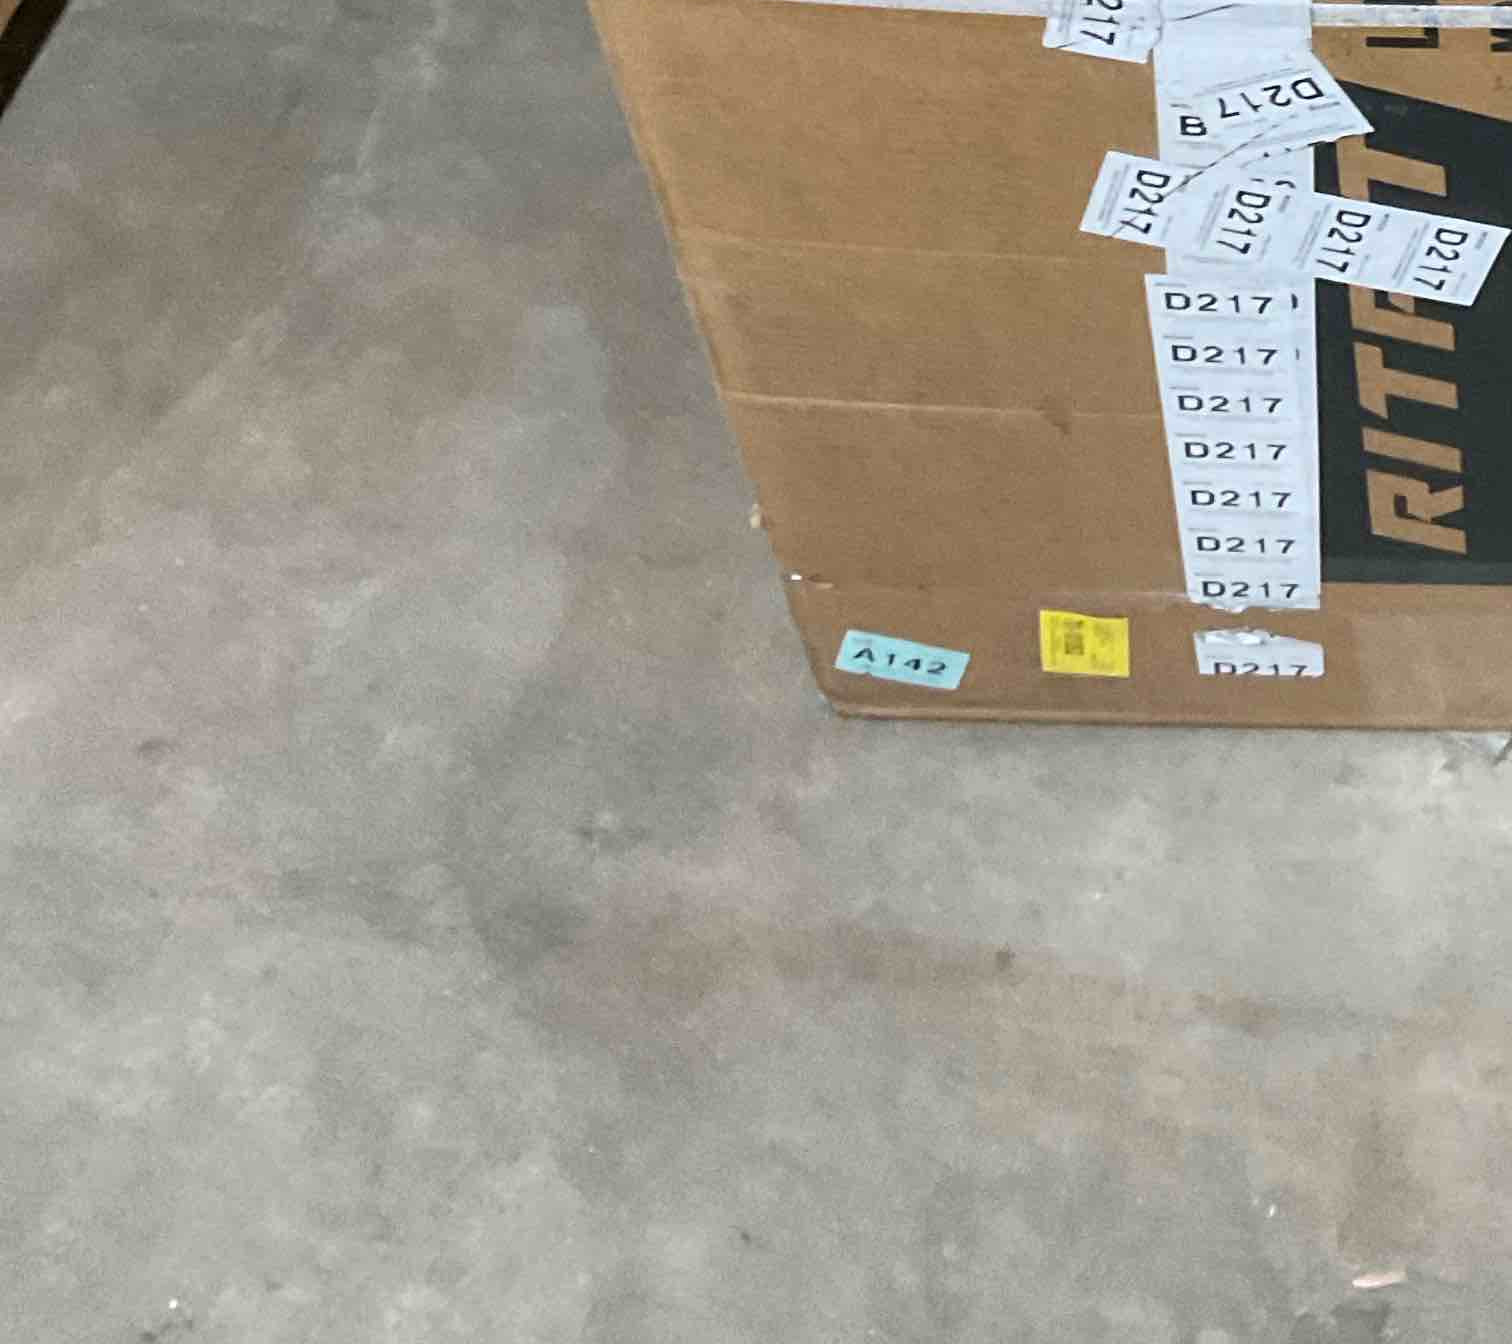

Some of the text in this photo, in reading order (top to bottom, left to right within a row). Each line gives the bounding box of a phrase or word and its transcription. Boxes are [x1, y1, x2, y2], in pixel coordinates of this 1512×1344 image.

[1217, 76, 1325, 119] D217
[1119, 169, 1172, 235] D217
[1215, 189, 1273, 255] D217
[1315, 209, 1373, 274] D217
[1412, 227, 1470, 292] D217
[1163, 291, 1274, 315] D217
[1170, 344, 1279, 366] D217
[1336, 134, 1468, 555] RITFT
[1176, 394, 1284, 414] D217
[1183, 441, 1288, 461] D217
[1190, 489, 1293, 509] D217
[1195, 535, 1297, 555] D217
[1201, 580, 1301, 600] D217
[852, 646, 948, 676] A142
